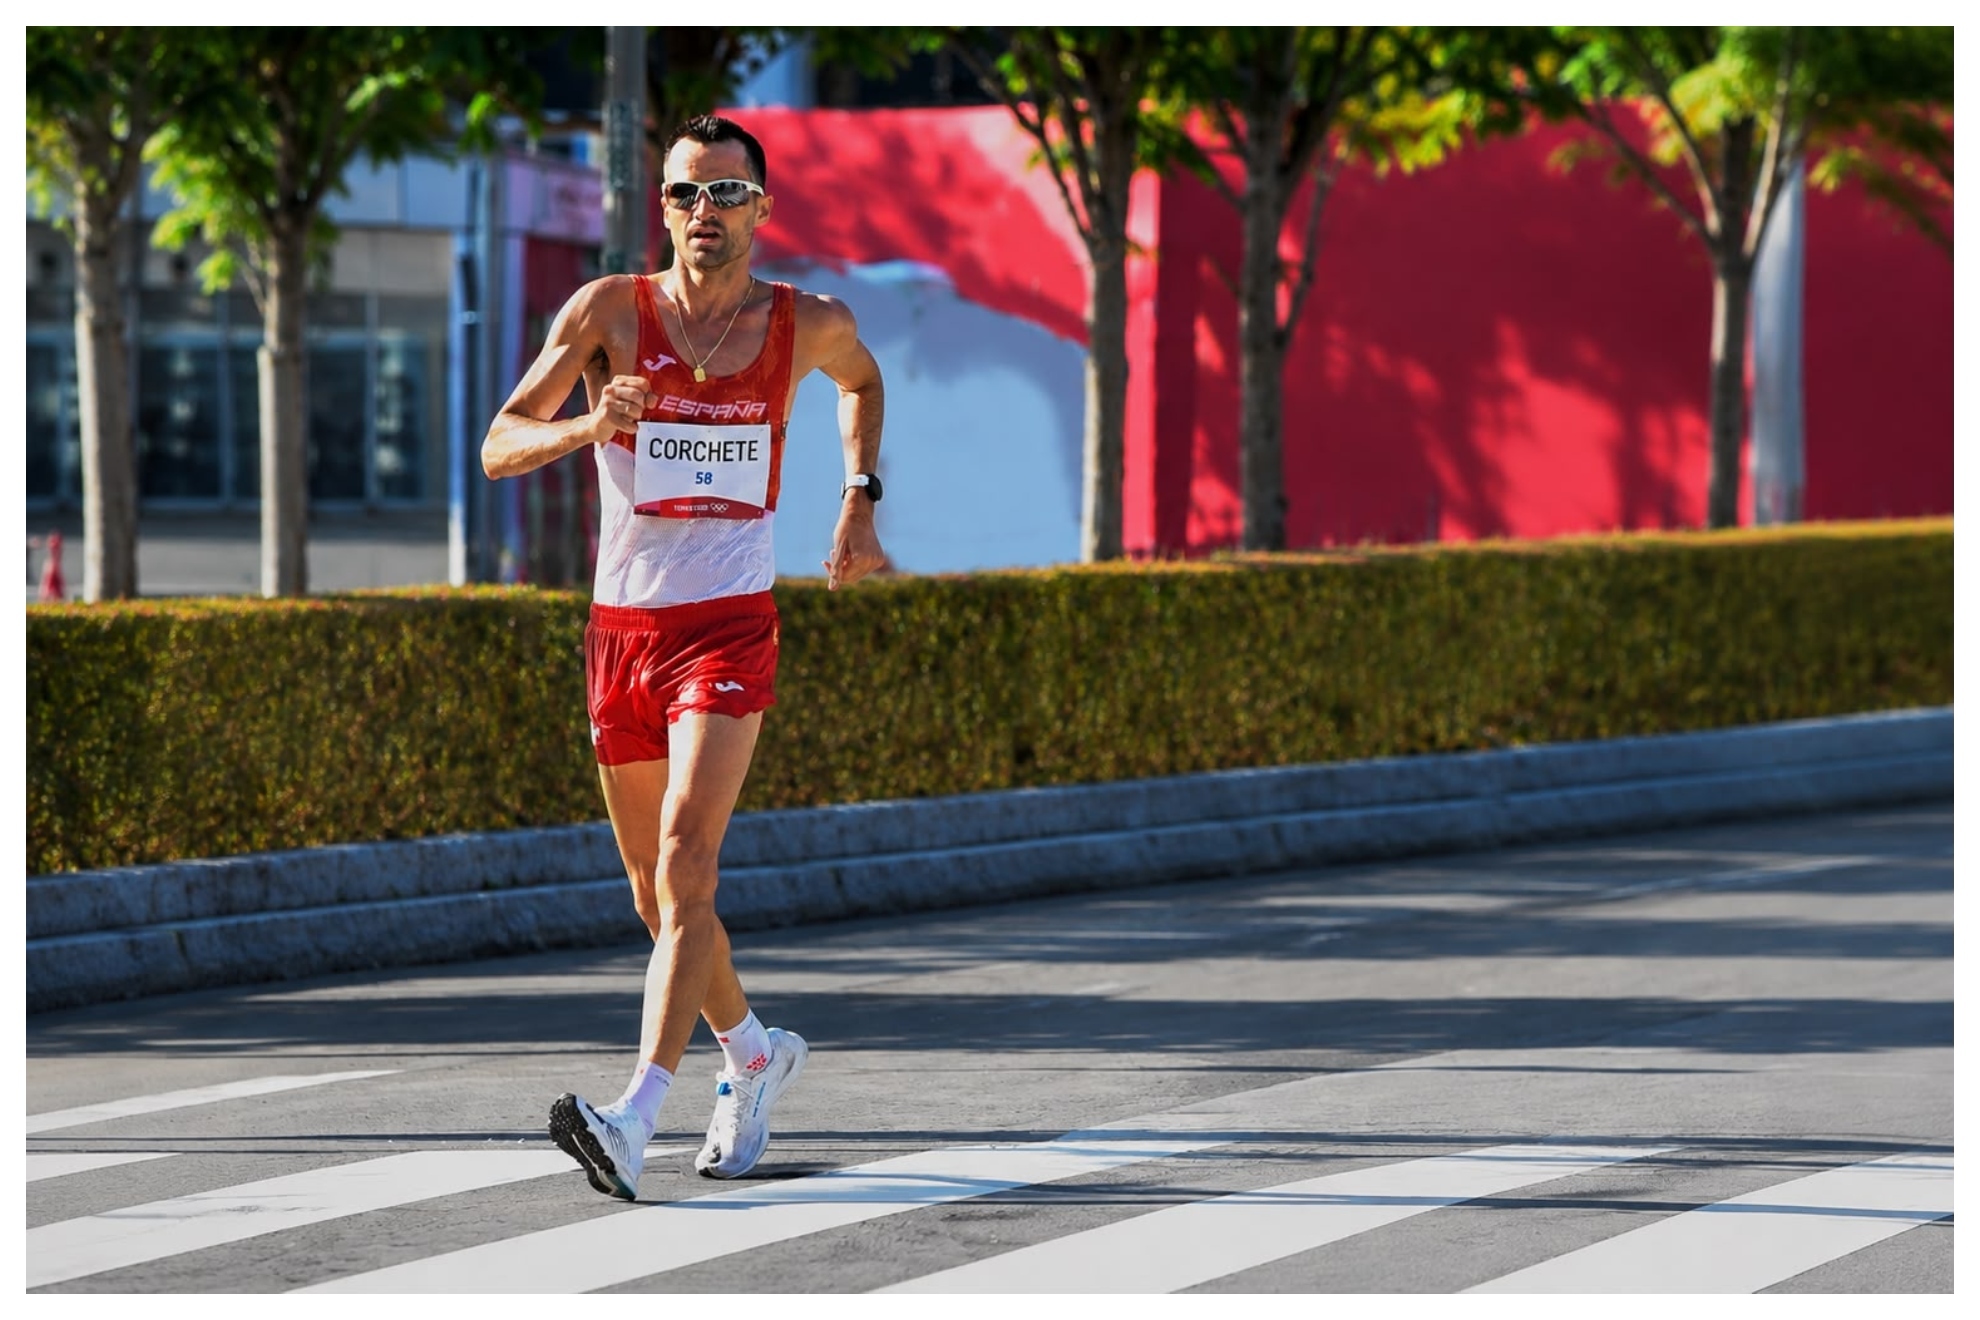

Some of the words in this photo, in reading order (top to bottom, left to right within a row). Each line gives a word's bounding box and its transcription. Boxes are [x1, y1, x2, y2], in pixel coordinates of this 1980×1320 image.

[658, 395, 767, 419] ESPAÑA
[649, 438, 758, 462] CORCHETE
[695, 472, 713, 485] 58
